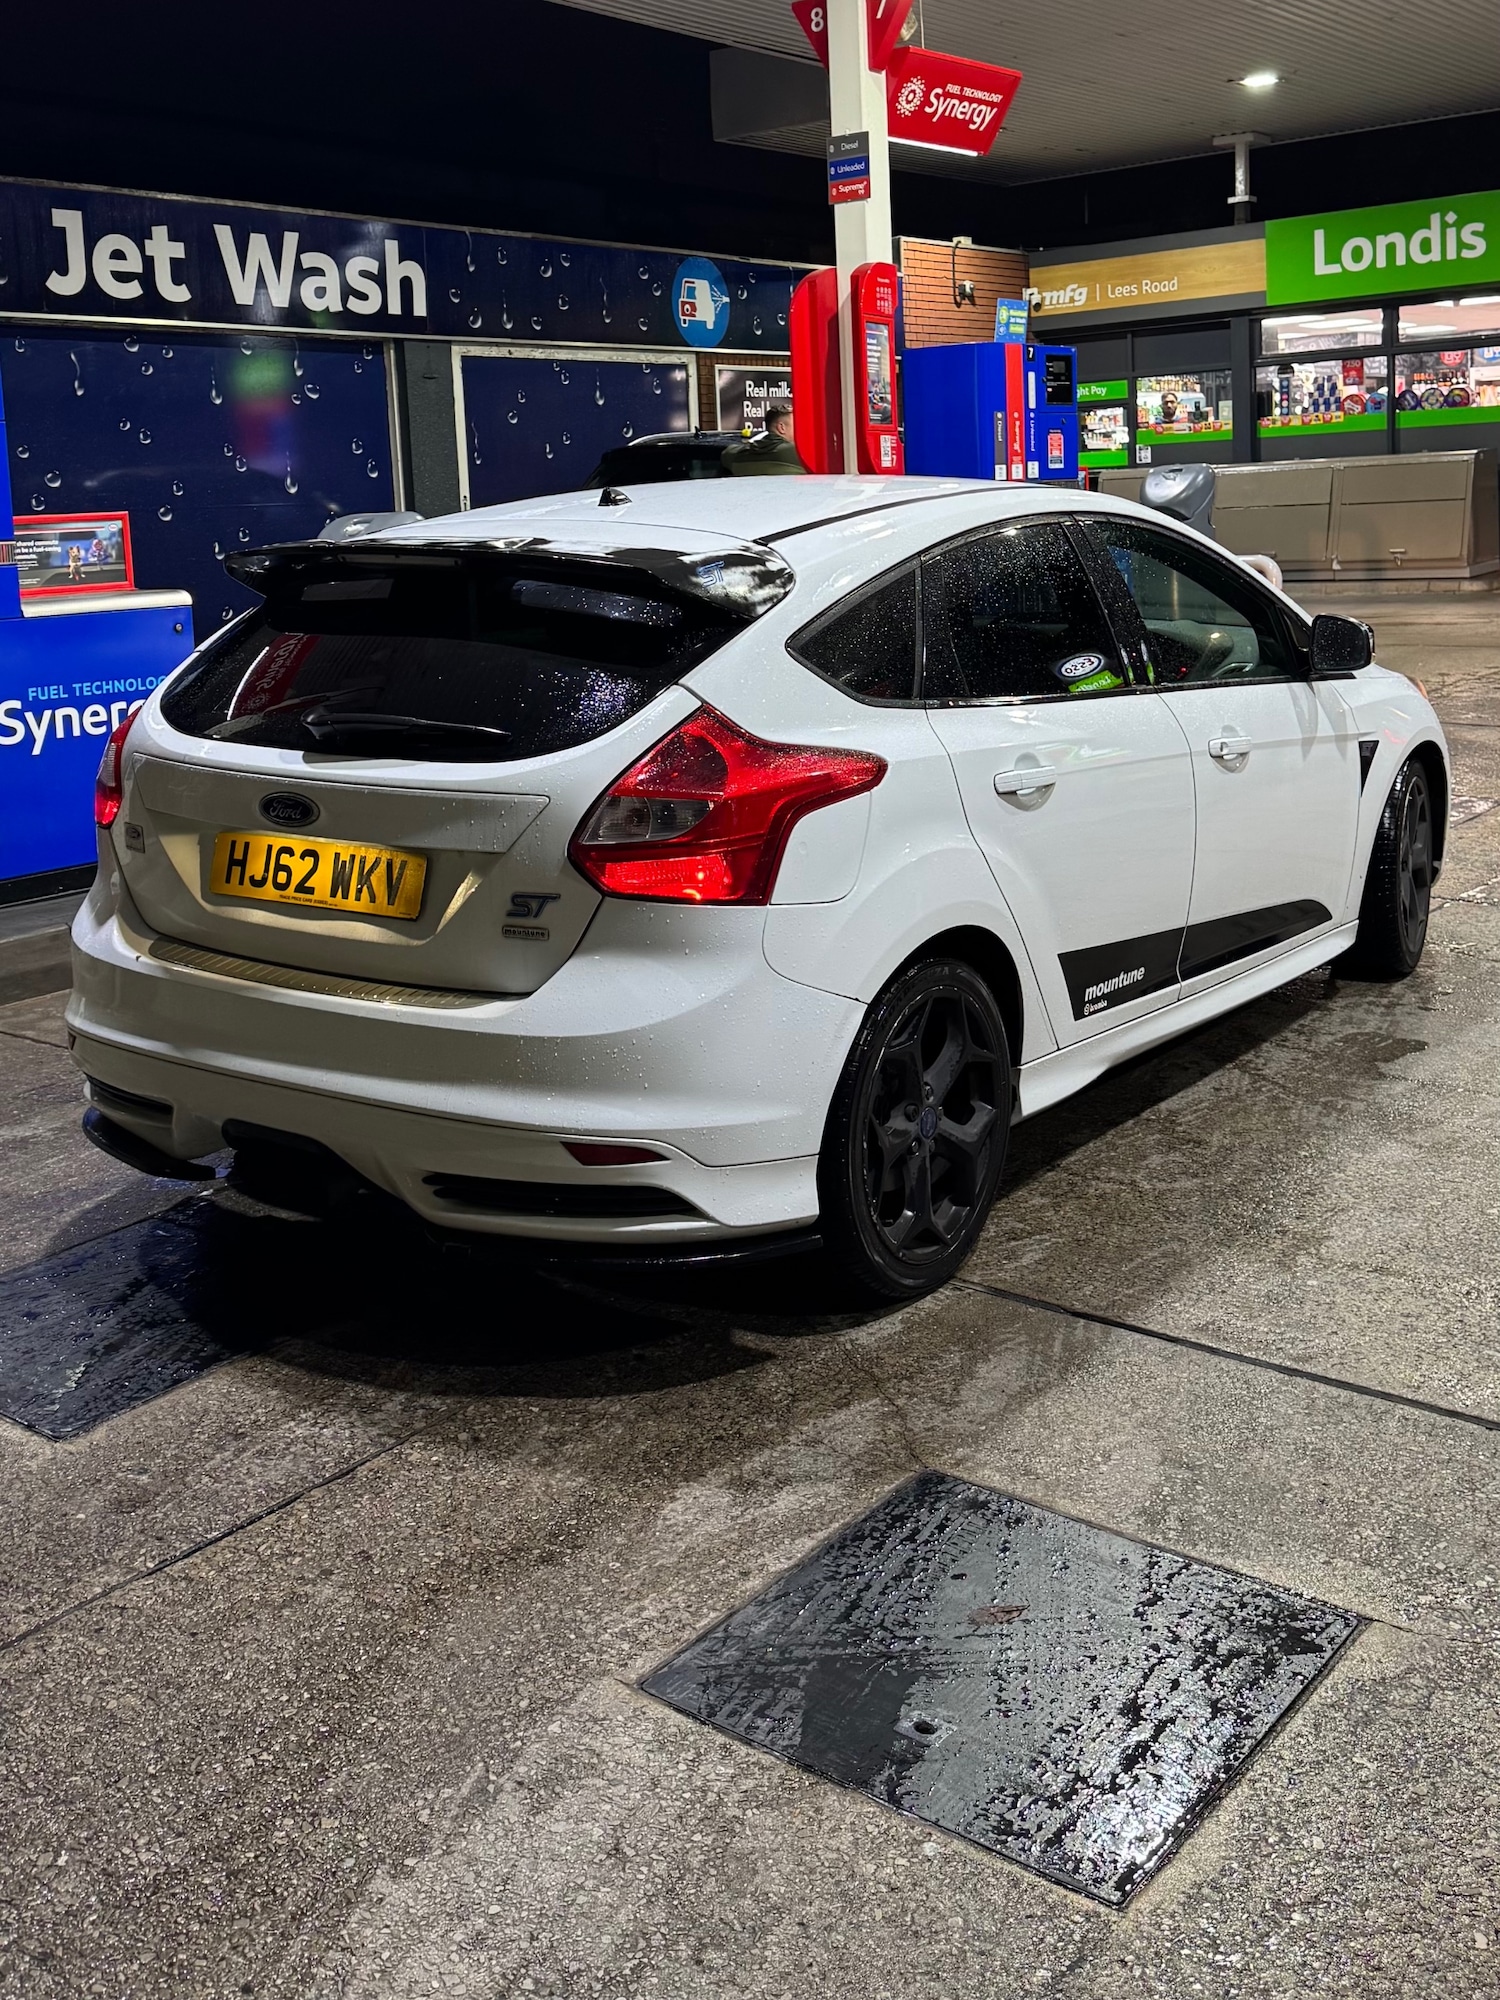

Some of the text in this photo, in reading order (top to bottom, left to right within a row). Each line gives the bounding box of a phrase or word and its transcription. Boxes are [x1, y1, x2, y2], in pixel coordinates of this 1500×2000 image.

[810, 7, 824, 33] 8
[945, 83, 1003, 103] FUEL TECHNOLOGY
[924, 88, 997, 131] Synergy
[841, 140, 859, 151] Diesel
[837, 161, 865, 173] Unleaded
[1314, 211, 1487, 275] Londis
[45, 208, 427, 316] Jet Wash
[1042, 283, 1088, 306] mfg
[1107, 276, 1178, 298] Lees Road
[1027, 347, 1034, 358] 7
[745, 380, 768, 397] Real
[1091, 386, 1107, 397] Pay
[743, 400, 765, 418] Real
[697, 561, 725, 588] ST
[28, 685, 68, 701] FUEL
[269, 799, 302, 820] Ford
[225, 840, 407, 906] HJ62 WKV
[506, 892, 561, 918] ST
[504, 928, 546, 938] mountune
[1084, 966, 1146, 1002] mountune
